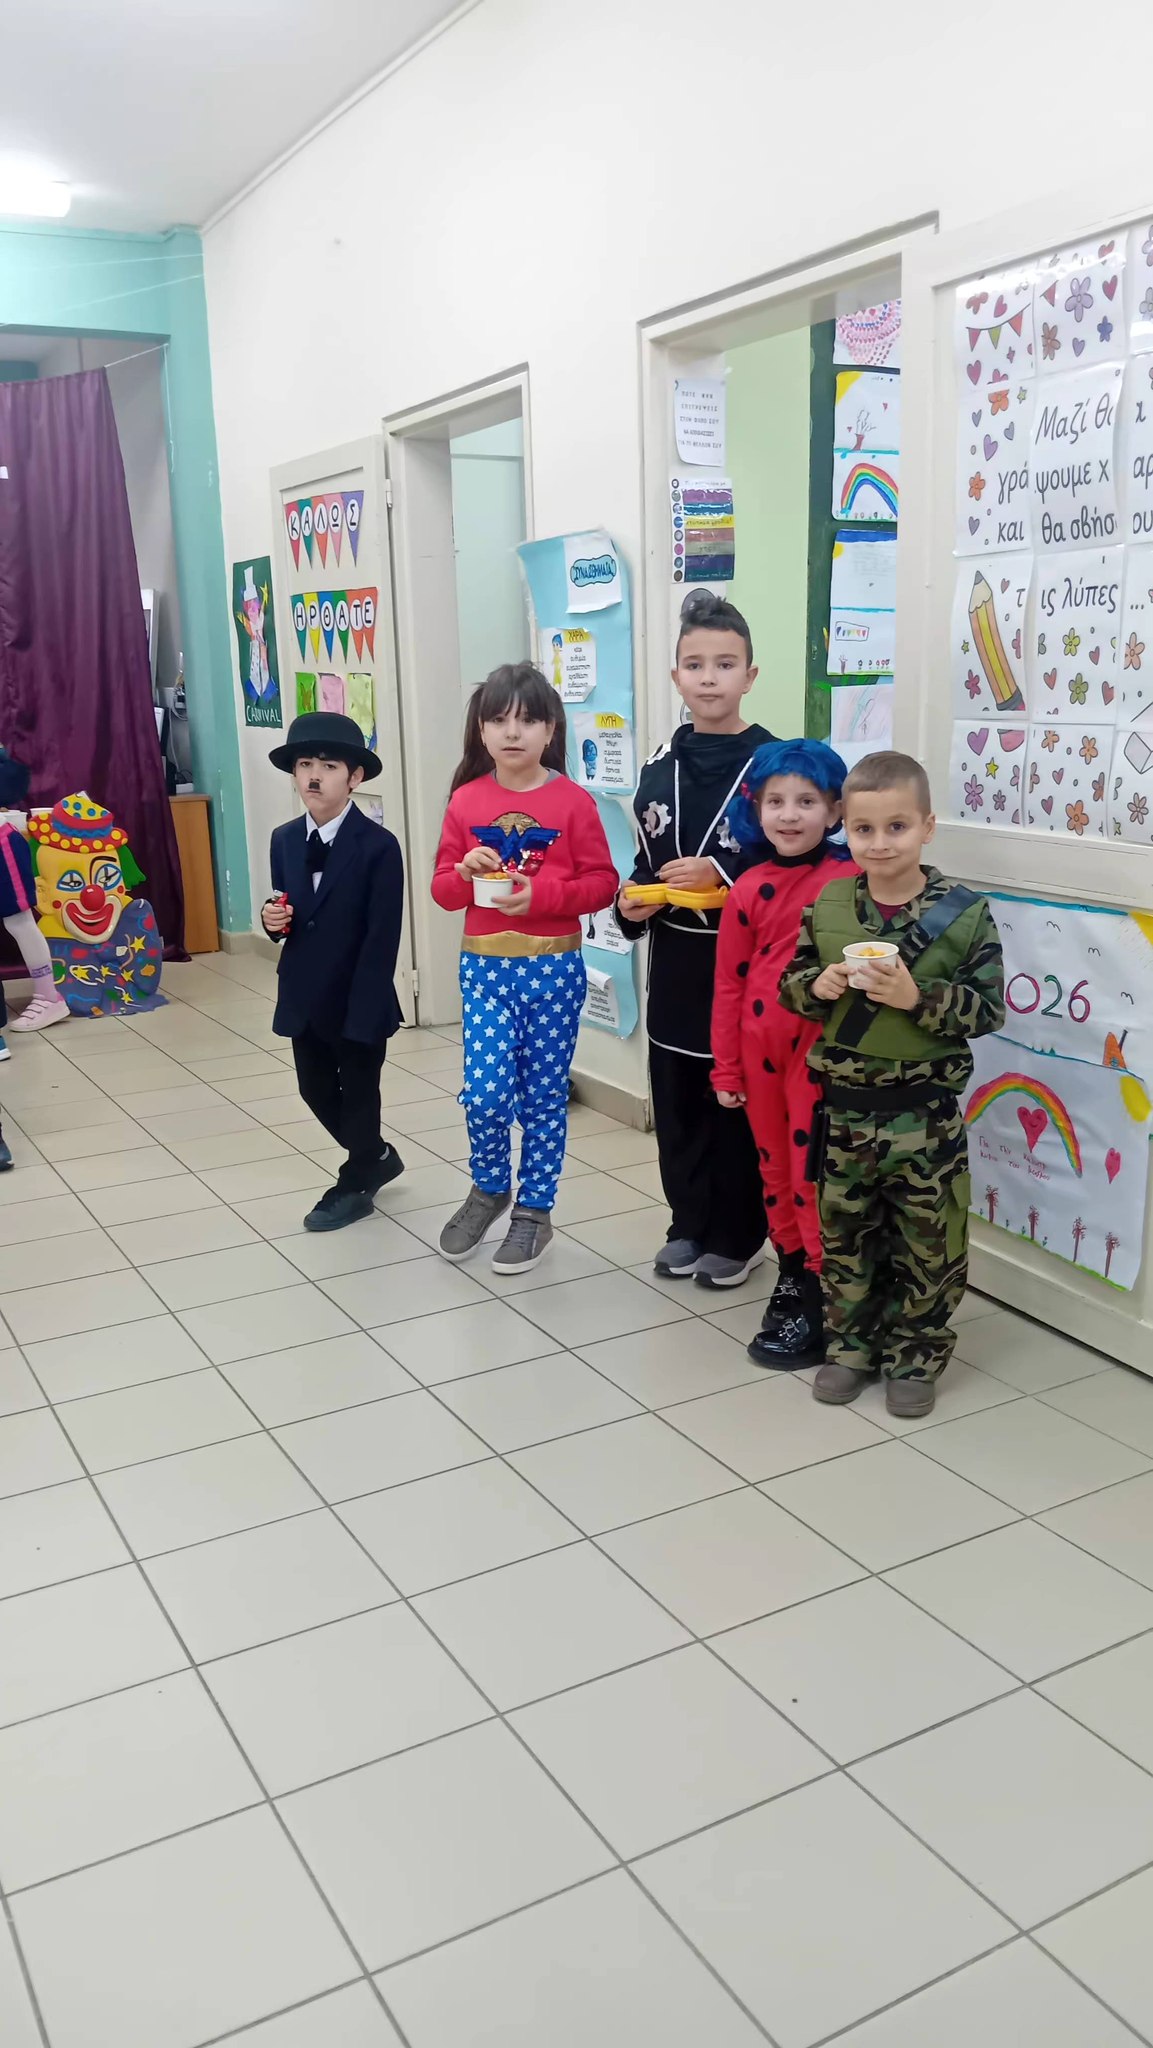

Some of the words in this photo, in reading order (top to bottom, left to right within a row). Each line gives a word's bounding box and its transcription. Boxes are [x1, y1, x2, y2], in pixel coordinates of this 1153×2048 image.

[1034, 398, 1090, 445] Μαζί
[290, 503, 357, 537] ΚΑΛΩΣ
[997, 520, 1025, 544] και
[1041, 511, 1067, 544] θα
[1061, 577, 1119, 614] λύπες
[295, 600, 372, 627] ΗΡΘΑΤΕ
[246, 704, 282, 723] CARNIVAL
[1005, 972, 1091, 1023] 026
